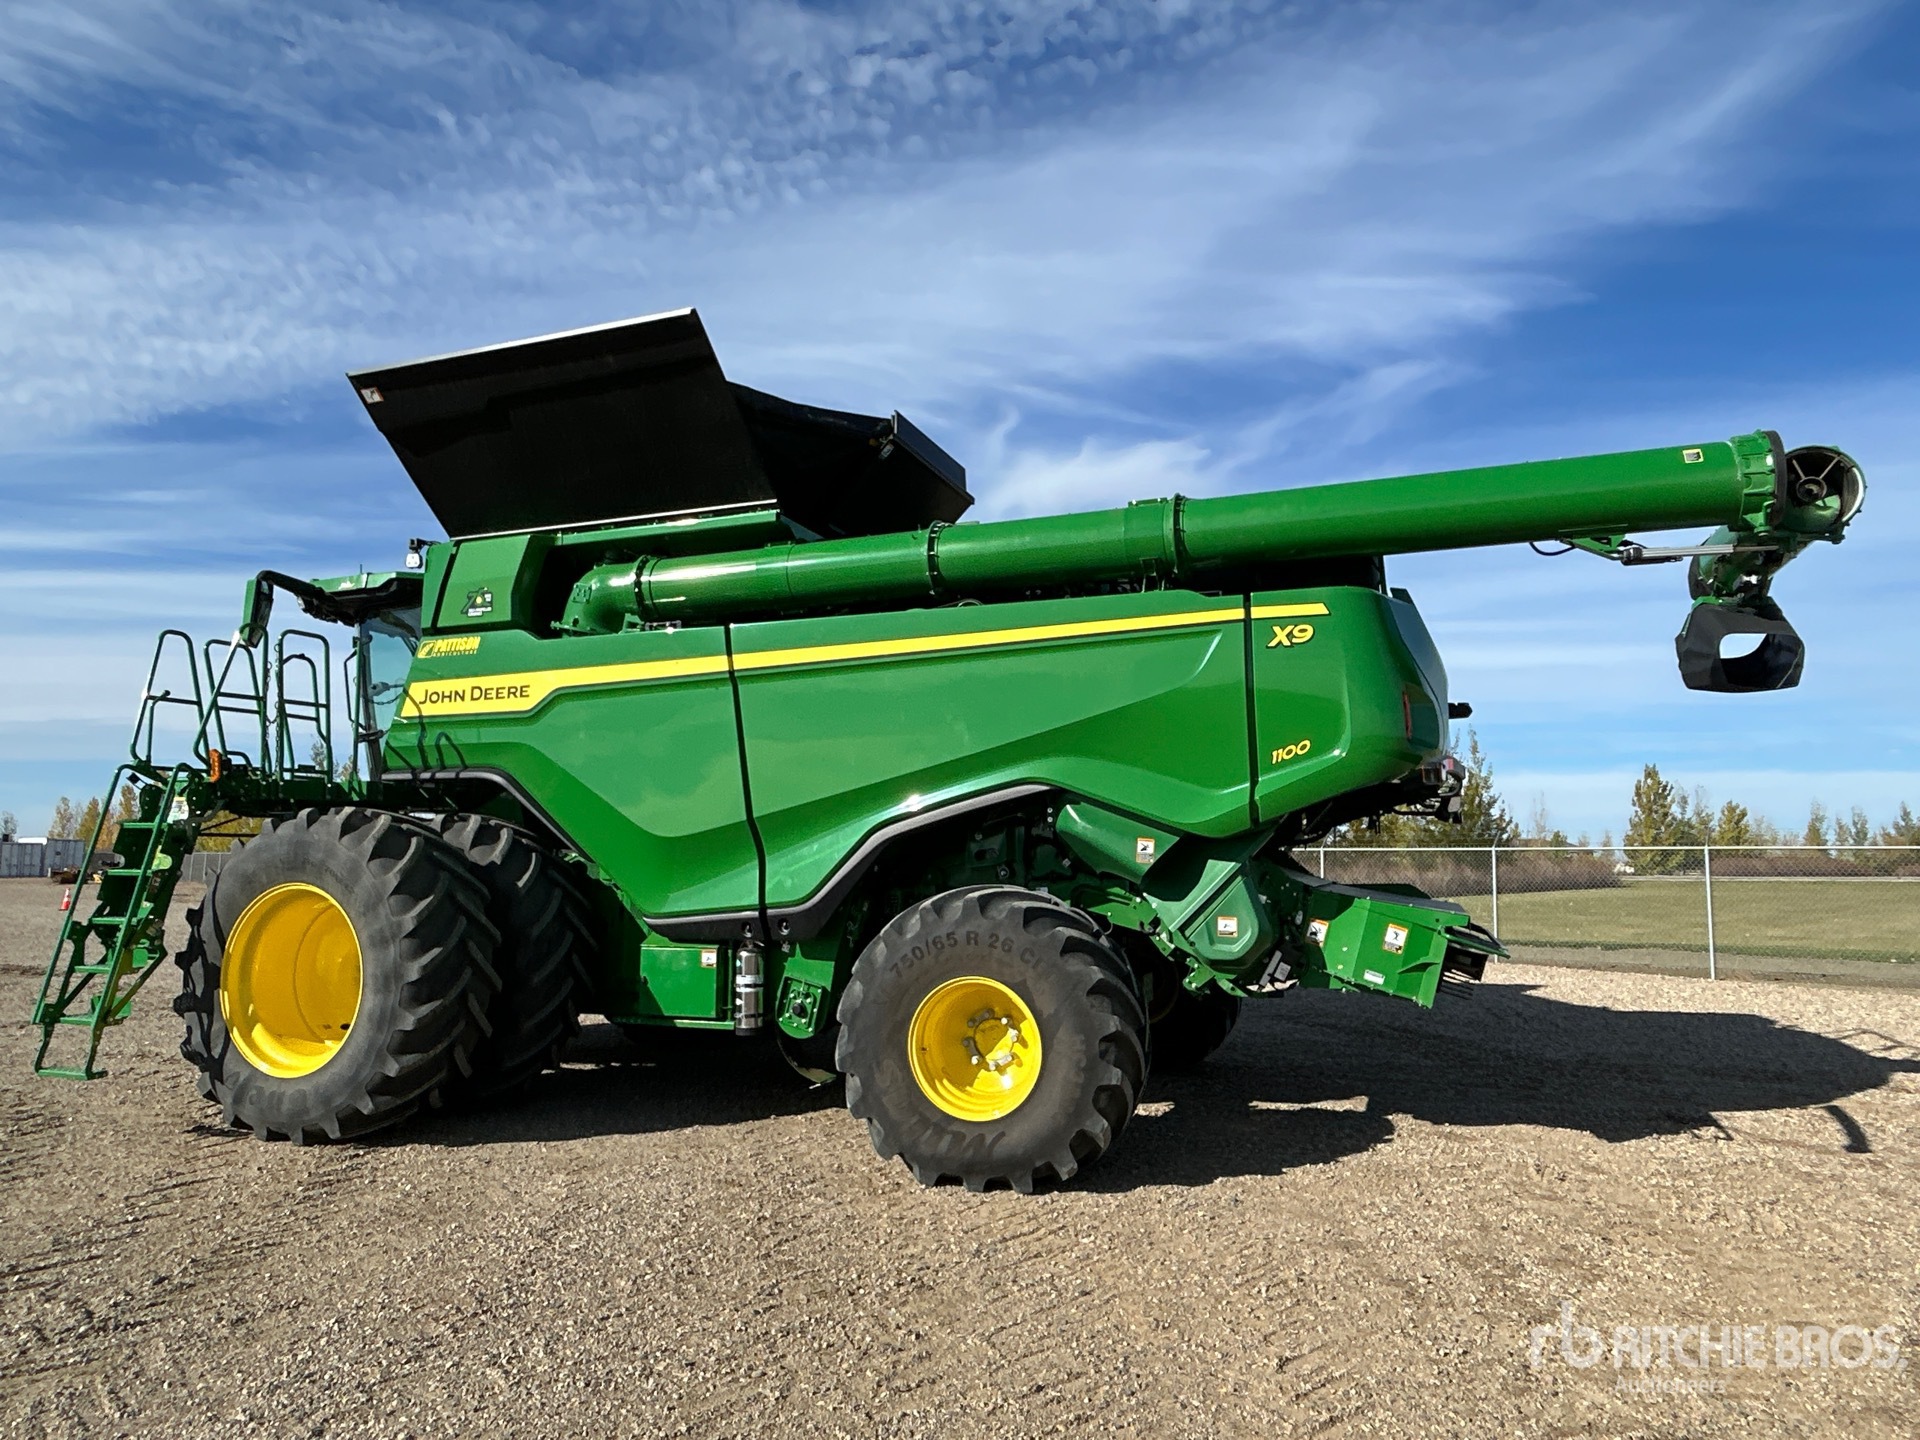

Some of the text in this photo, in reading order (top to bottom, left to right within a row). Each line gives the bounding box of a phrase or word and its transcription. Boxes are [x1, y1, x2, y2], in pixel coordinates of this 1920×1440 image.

[435, 636, 481, 652] PATTISON
[1267, 624, 1315, 648] X9
[418, 684, 531, 705] JOHN DEERE
[1271, 739, 1311, 765] 1100
[889, 930, 959, 979] 750/65
[965, 930, 980, 947] R
[987, 932, 1015, 954] 26
